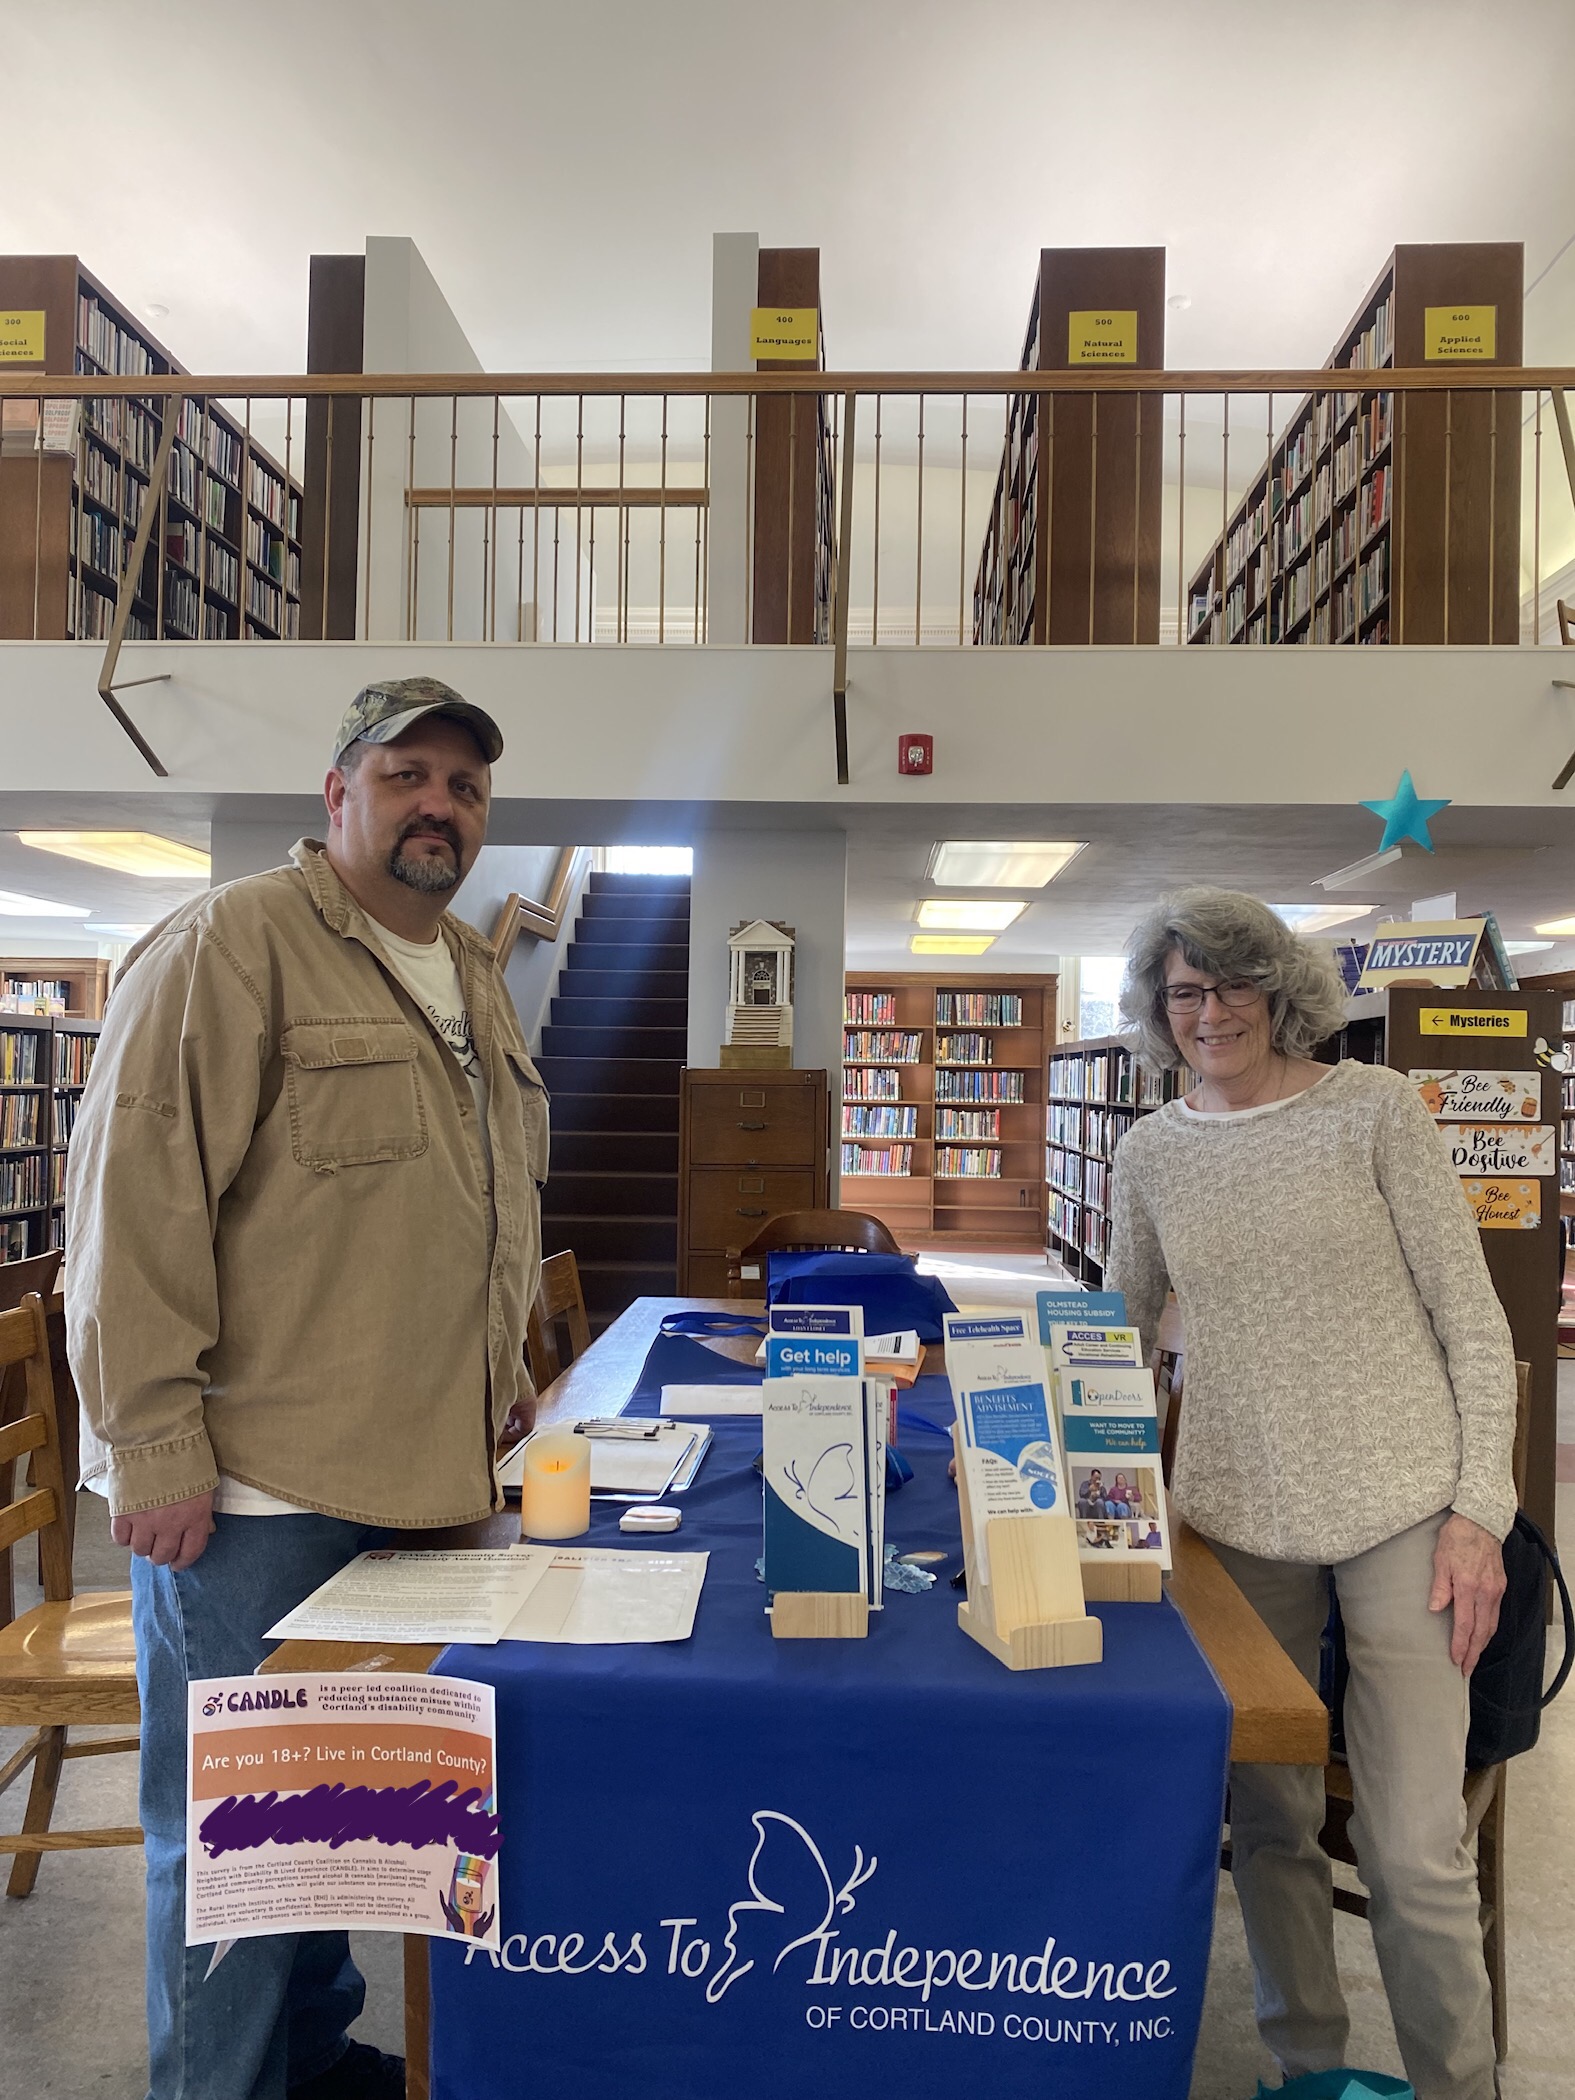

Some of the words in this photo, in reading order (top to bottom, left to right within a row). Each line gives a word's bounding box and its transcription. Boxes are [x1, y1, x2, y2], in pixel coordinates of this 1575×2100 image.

[756, 337, 812, 345] Languages
[1440, 336, 1481, 344] Applied
[1371, 940, 1471, 968] MYSTERY
[1450, 1015, 1510, 1028] Mysteries
[1462, 1075, 1491, 1093] Bee
[1438, 1091, 1514, 1119] Friendly
[1473, 1130, 1505, 1151] Bee
[1452, 1147, 1529, 1173] Positive
[1485, 1186, 1511, 1203] Bee
[1476, 1205, 1521, 1222] Honest
[780, 1347, 810, 1363] Get
[815, 1348, 851, 1368] help
[227, 1688, 308, 1712] CANDLE
[384, 1685, 428, 1694] coalition
[430, 1687, 472, 1701] dedicated
[318, 1694, 365, 1704] reducing
[368, 1694, 417, 1702] substance
[420, 1696, 451, 1706] misuse
[454, 1700, 481, 1712] within
[378, 1704, 424, 1715] disability
[202, 1754, 230, 1770] Are
[236, 1753, 264, 1770] you
[271, 1747, 311, 1763] 18+?
[316, 1746, 346, 1760] Live
[351, 1746, 364, 1760] in
[371, 1746, 432, 1763] Cortland
[437, 1750, 486, 1775] County?
[659, 1918, 710, 1977] To
[806, 1929, 1178, 2002] Independence
[805, 2006, 842, 2028] OF
[849, 2006, 995, 2036] CORTLAND
[1003, 2014, 1120, 2048] COUNTY,
[1130, 2016, 1175, 2041] INC.
